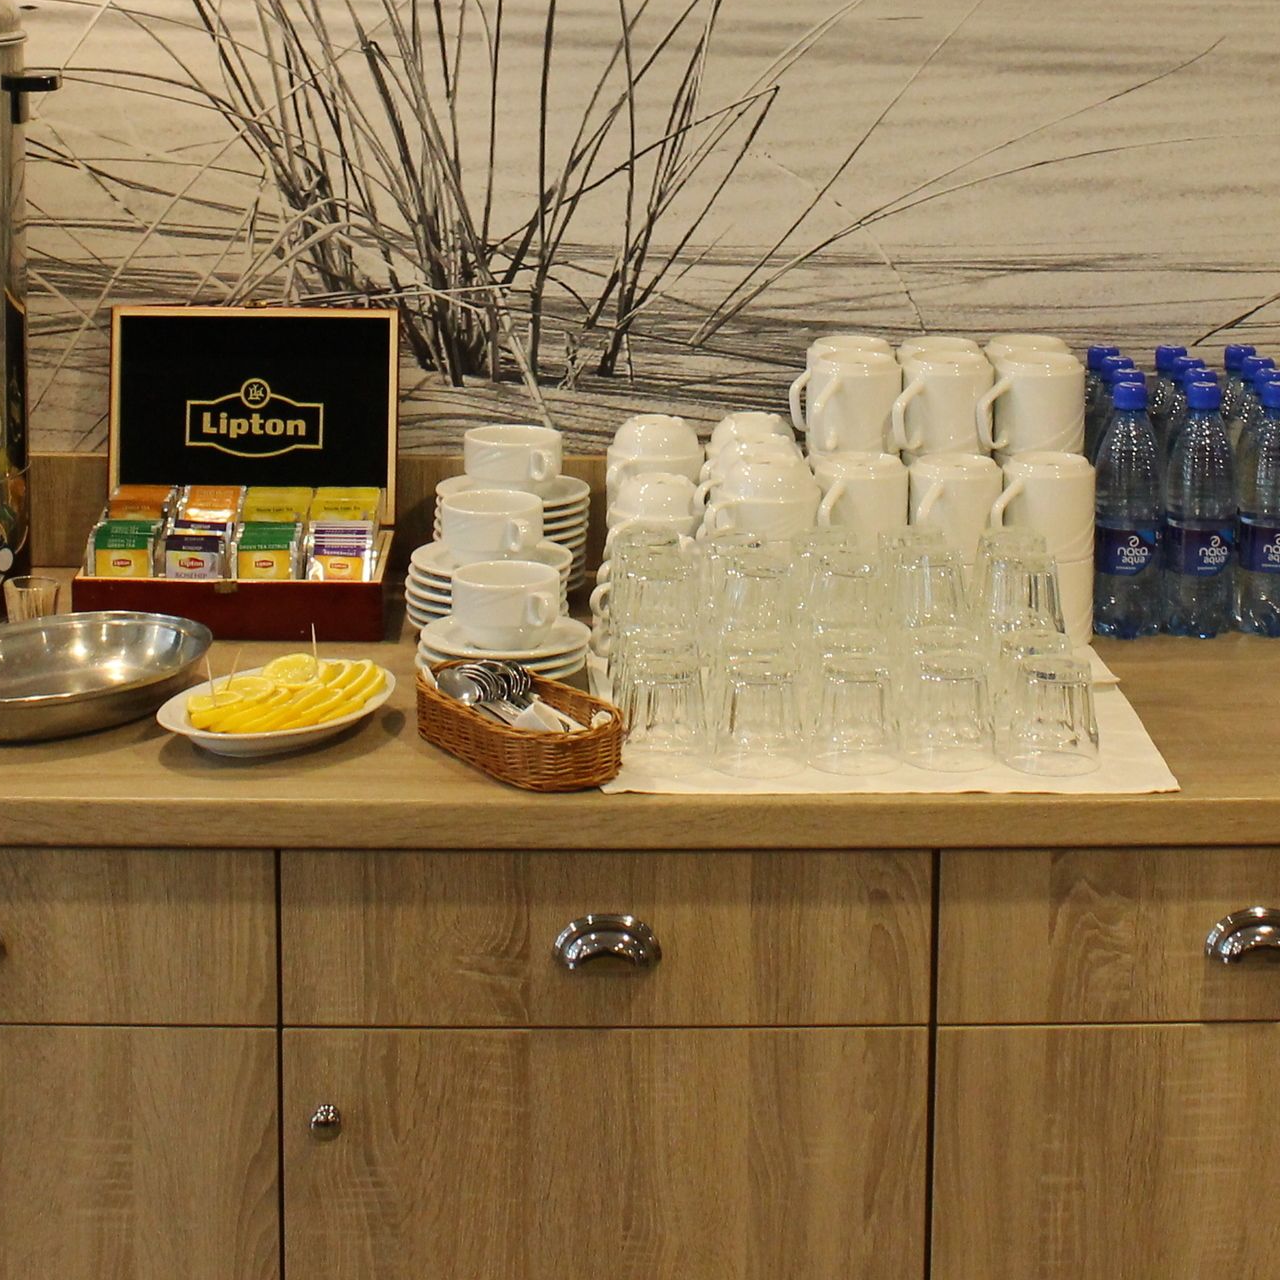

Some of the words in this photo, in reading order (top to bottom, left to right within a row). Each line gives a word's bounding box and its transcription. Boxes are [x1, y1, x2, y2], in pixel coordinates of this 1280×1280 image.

[202, 412, 306, 438] Lipton
[1117, 546, 1148, 556] nata
[1199, 546, 1228, 556] nata
[180, 559, 204, 568] Lipton
[1122, 556, 1145, 564] aqua
[1203, 555, 1226, 564] aqua
